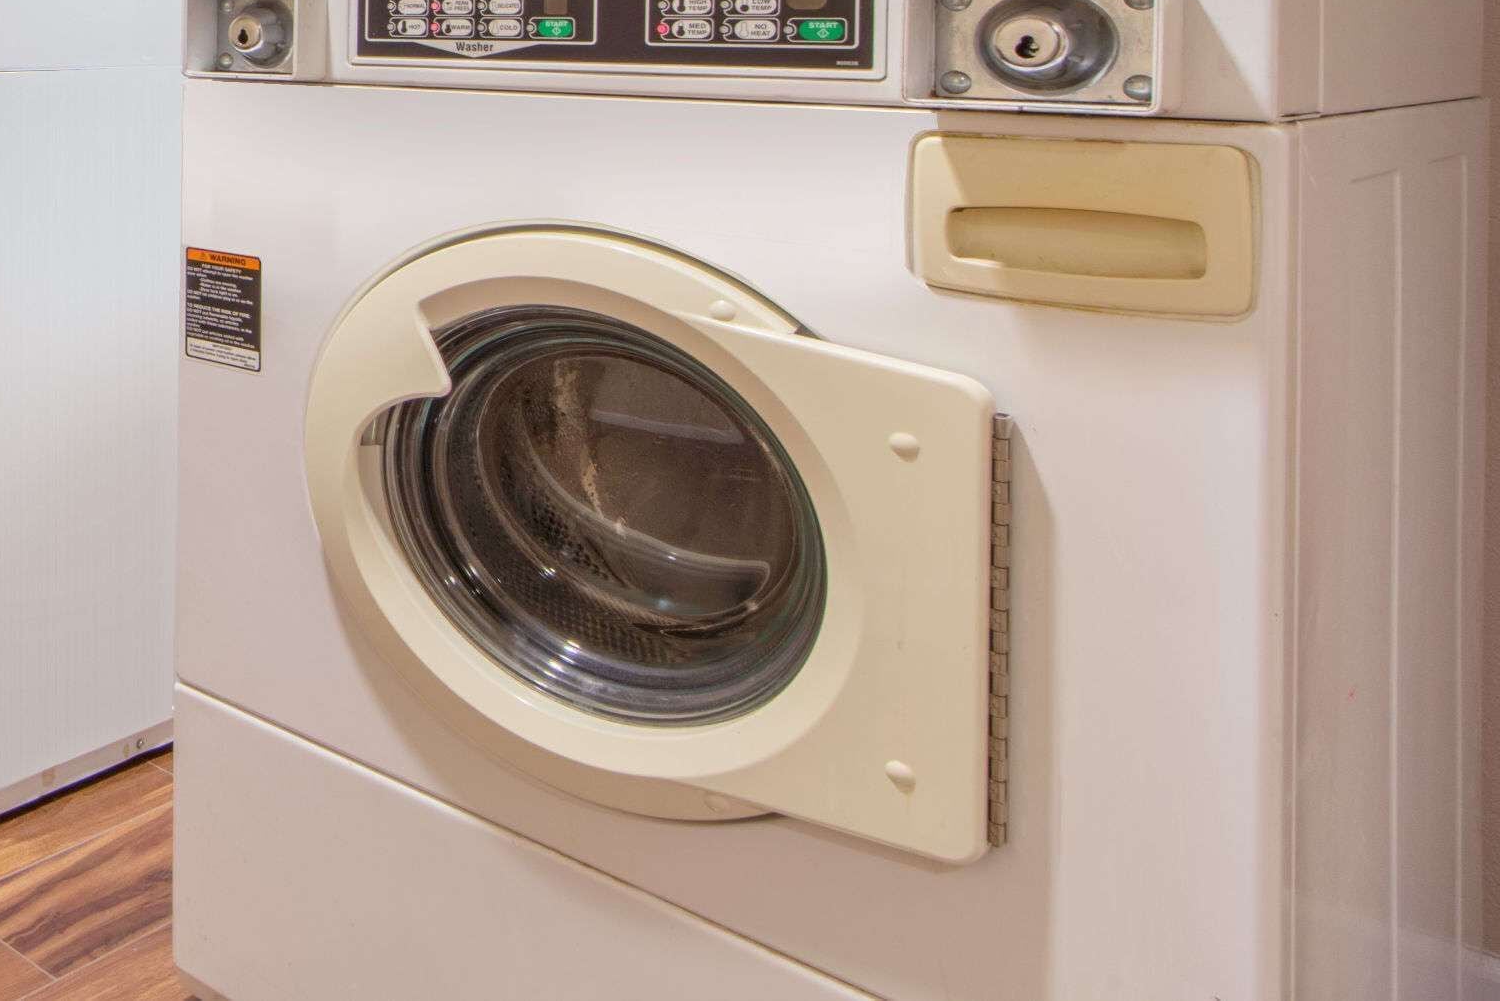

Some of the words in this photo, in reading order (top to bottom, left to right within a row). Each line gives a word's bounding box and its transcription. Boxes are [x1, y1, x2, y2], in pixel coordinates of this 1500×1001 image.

[808, 21, 839, 29] START
[456, 41, 494, 52] Washer
[210, 254, 246, 266] WARNING
